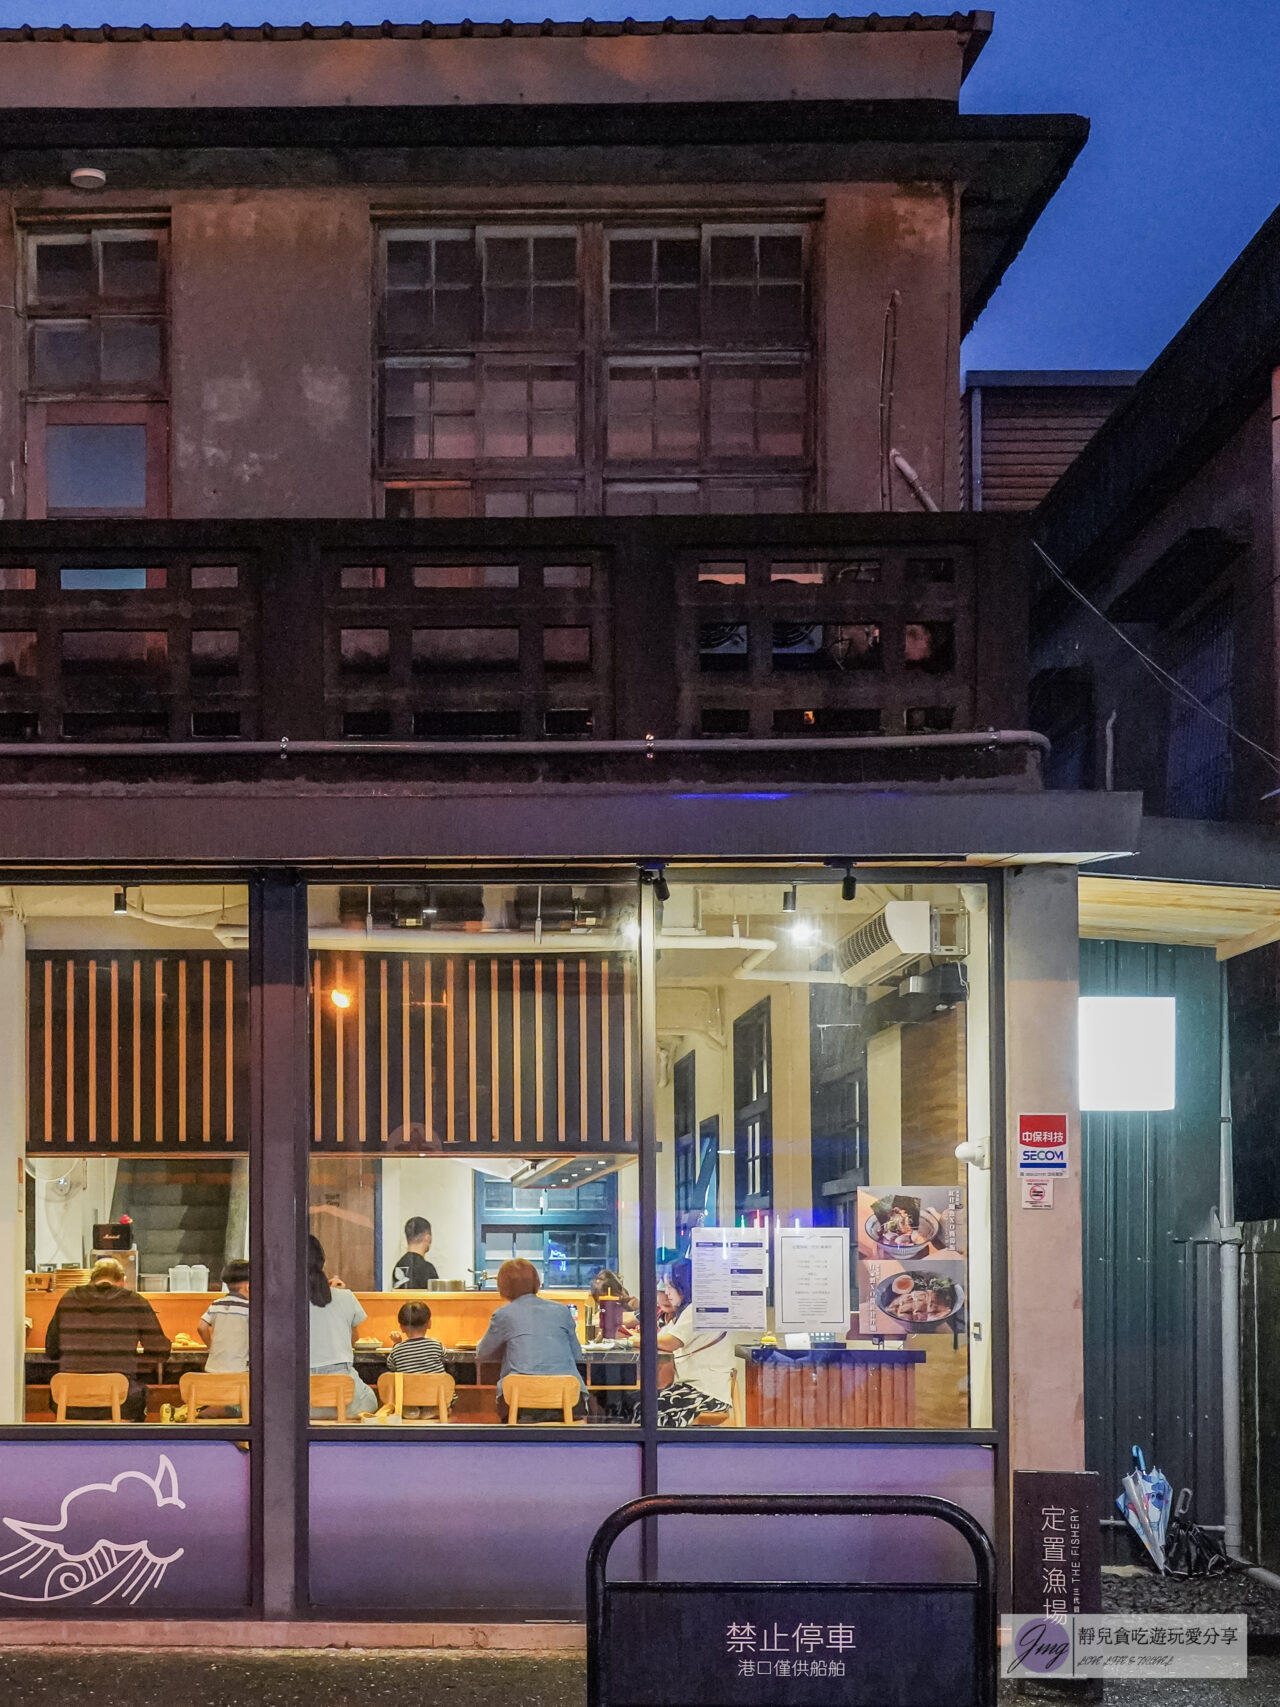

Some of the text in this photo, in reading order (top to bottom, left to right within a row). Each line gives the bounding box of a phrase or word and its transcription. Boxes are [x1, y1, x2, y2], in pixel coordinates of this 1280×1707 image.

[1022, 1131, 1064, 1143] 中保科技
[1022, 1150, 1064, 1161] SECOM
[1070, 1507, 1081, 1584] THE FISHERY
[1041, 1505, 1068, 1626] 定置漁場
[726, 1622, 857, 1653] 禁止停車
[738, 1659, 846, 1678] 港口僅供船舶
